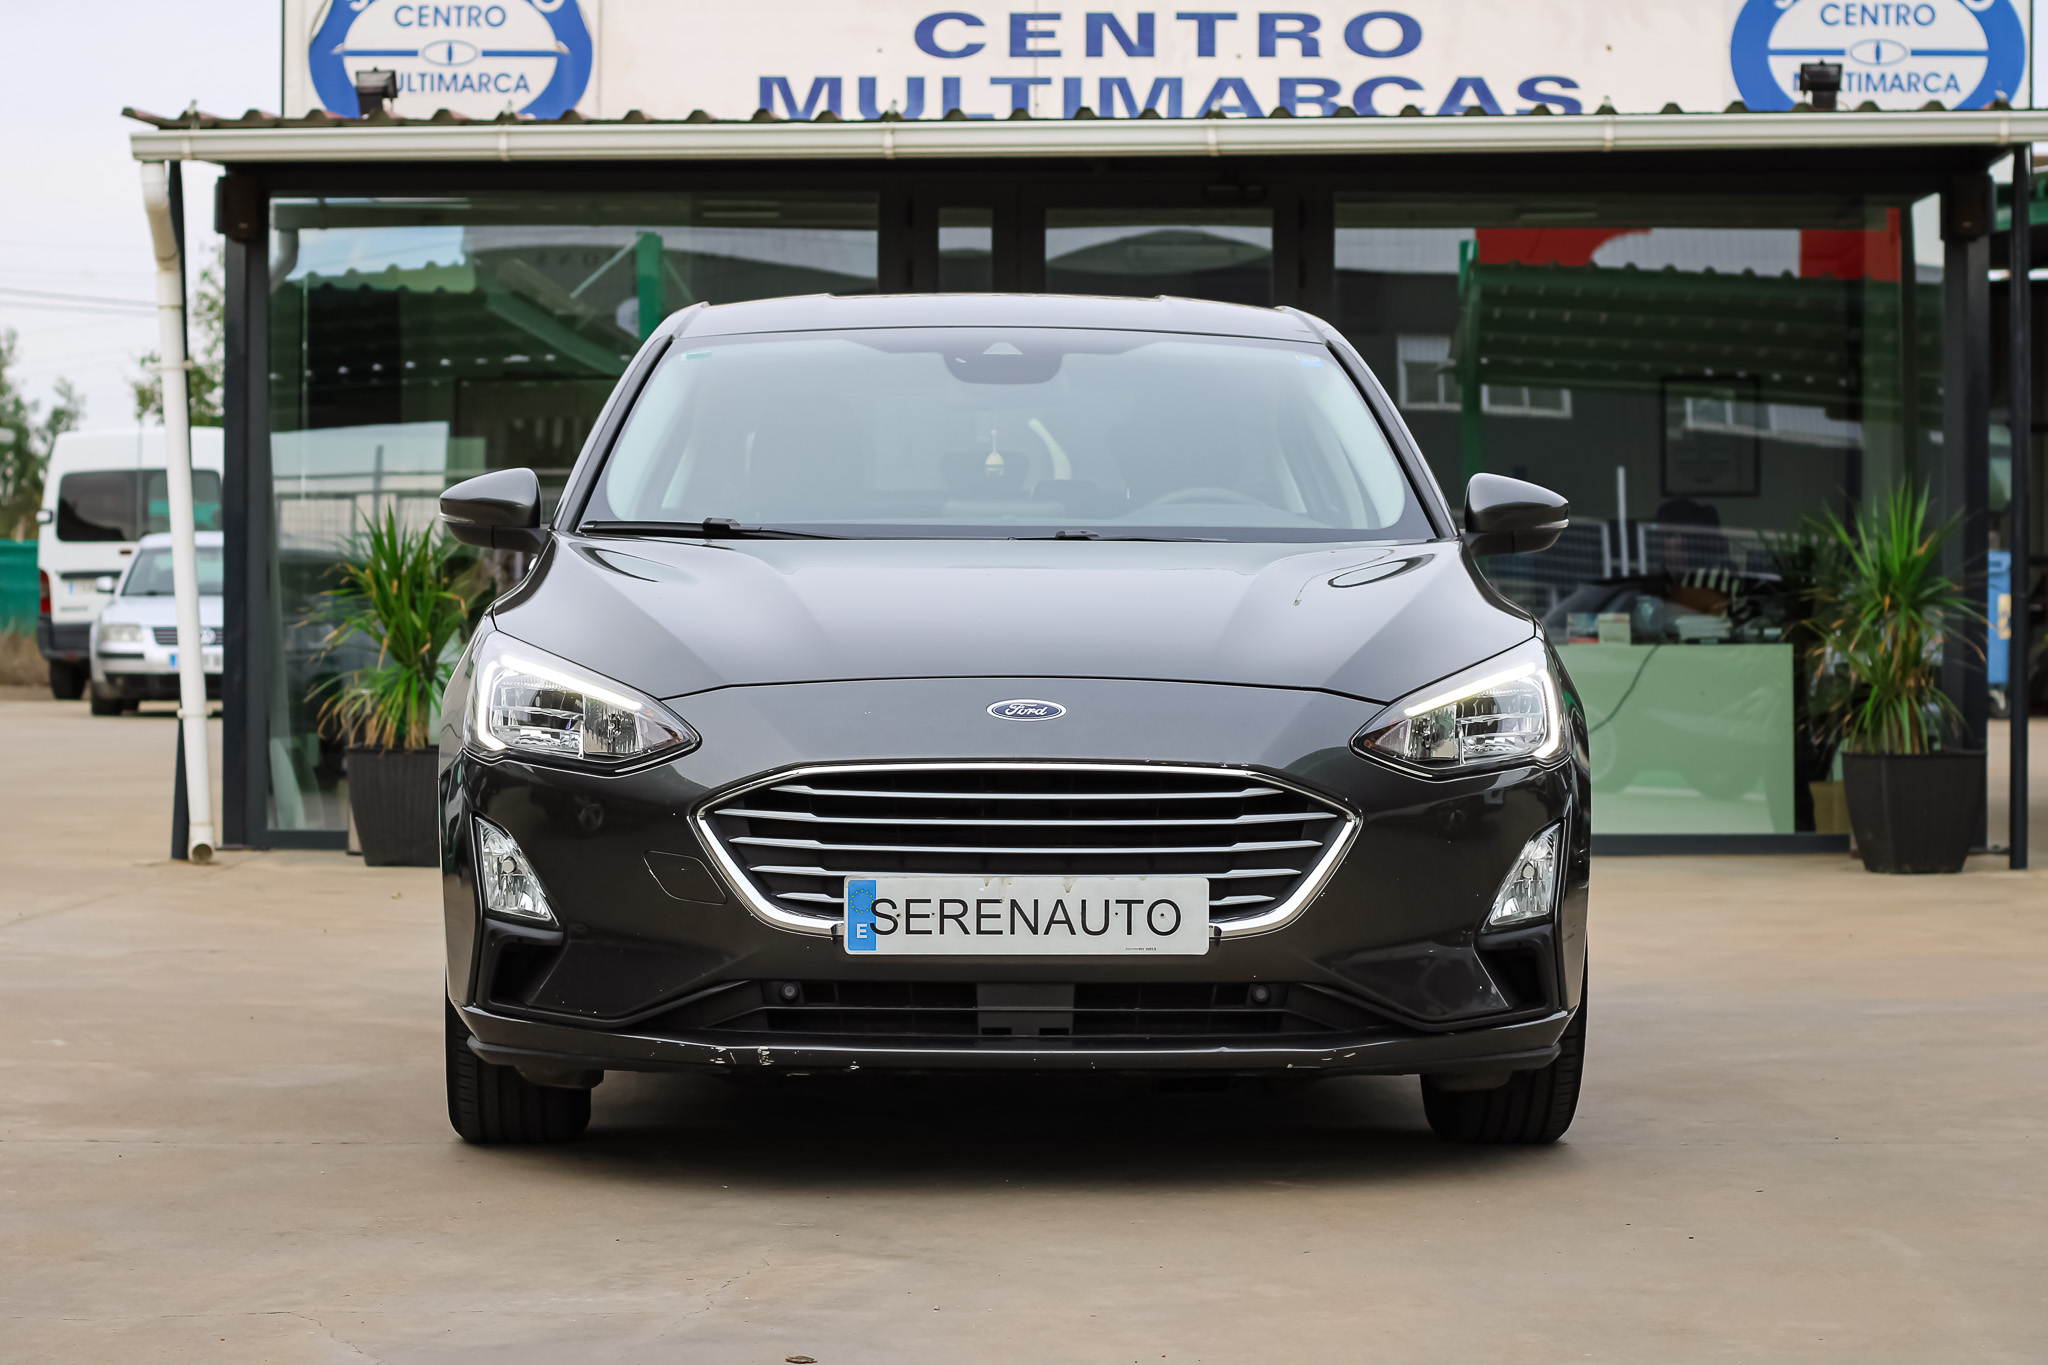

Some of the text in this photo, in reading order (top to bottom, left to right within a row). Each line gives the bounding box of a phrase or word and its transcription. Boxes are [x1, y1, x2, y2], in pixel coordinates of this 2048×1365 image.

[394, 5, 506, 28] CENTRO
[1820, 3, 1936, 27] CENTRO
[913, 10, 1422, 59] CENTRO
[758, 75, 1583, 120] MULTIMARCAS
[1004, 703, 1048, 716] Ford
[869, 897, 1183, 936] SERENAUTO
[856, 923, 868, 939] E
